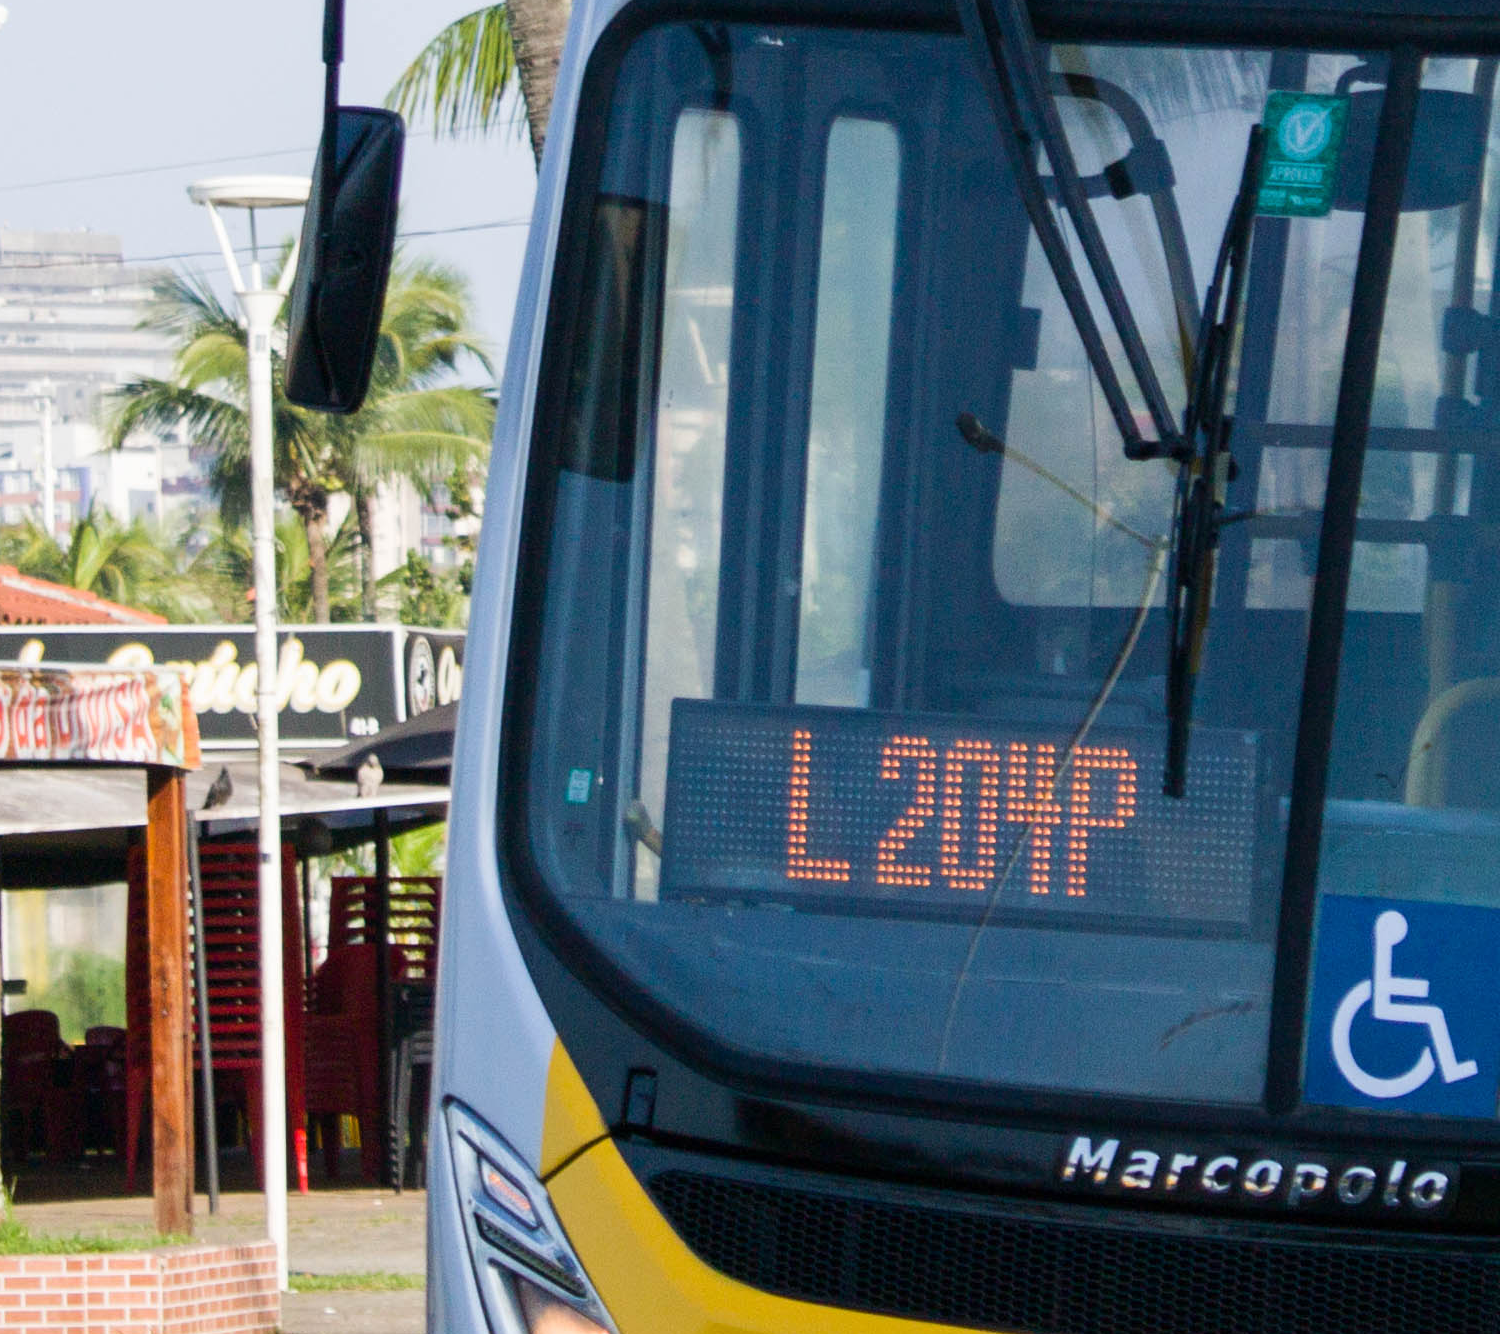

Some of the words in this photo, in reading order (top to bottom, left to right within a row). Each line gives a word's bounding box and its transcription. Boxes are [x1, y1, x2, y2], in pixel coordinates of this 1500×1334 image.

[786, 729, 851, 882] L
[876, 734, 1138, 897] 204P
[1061, 1136, 1449, 1209] Marcopolo
